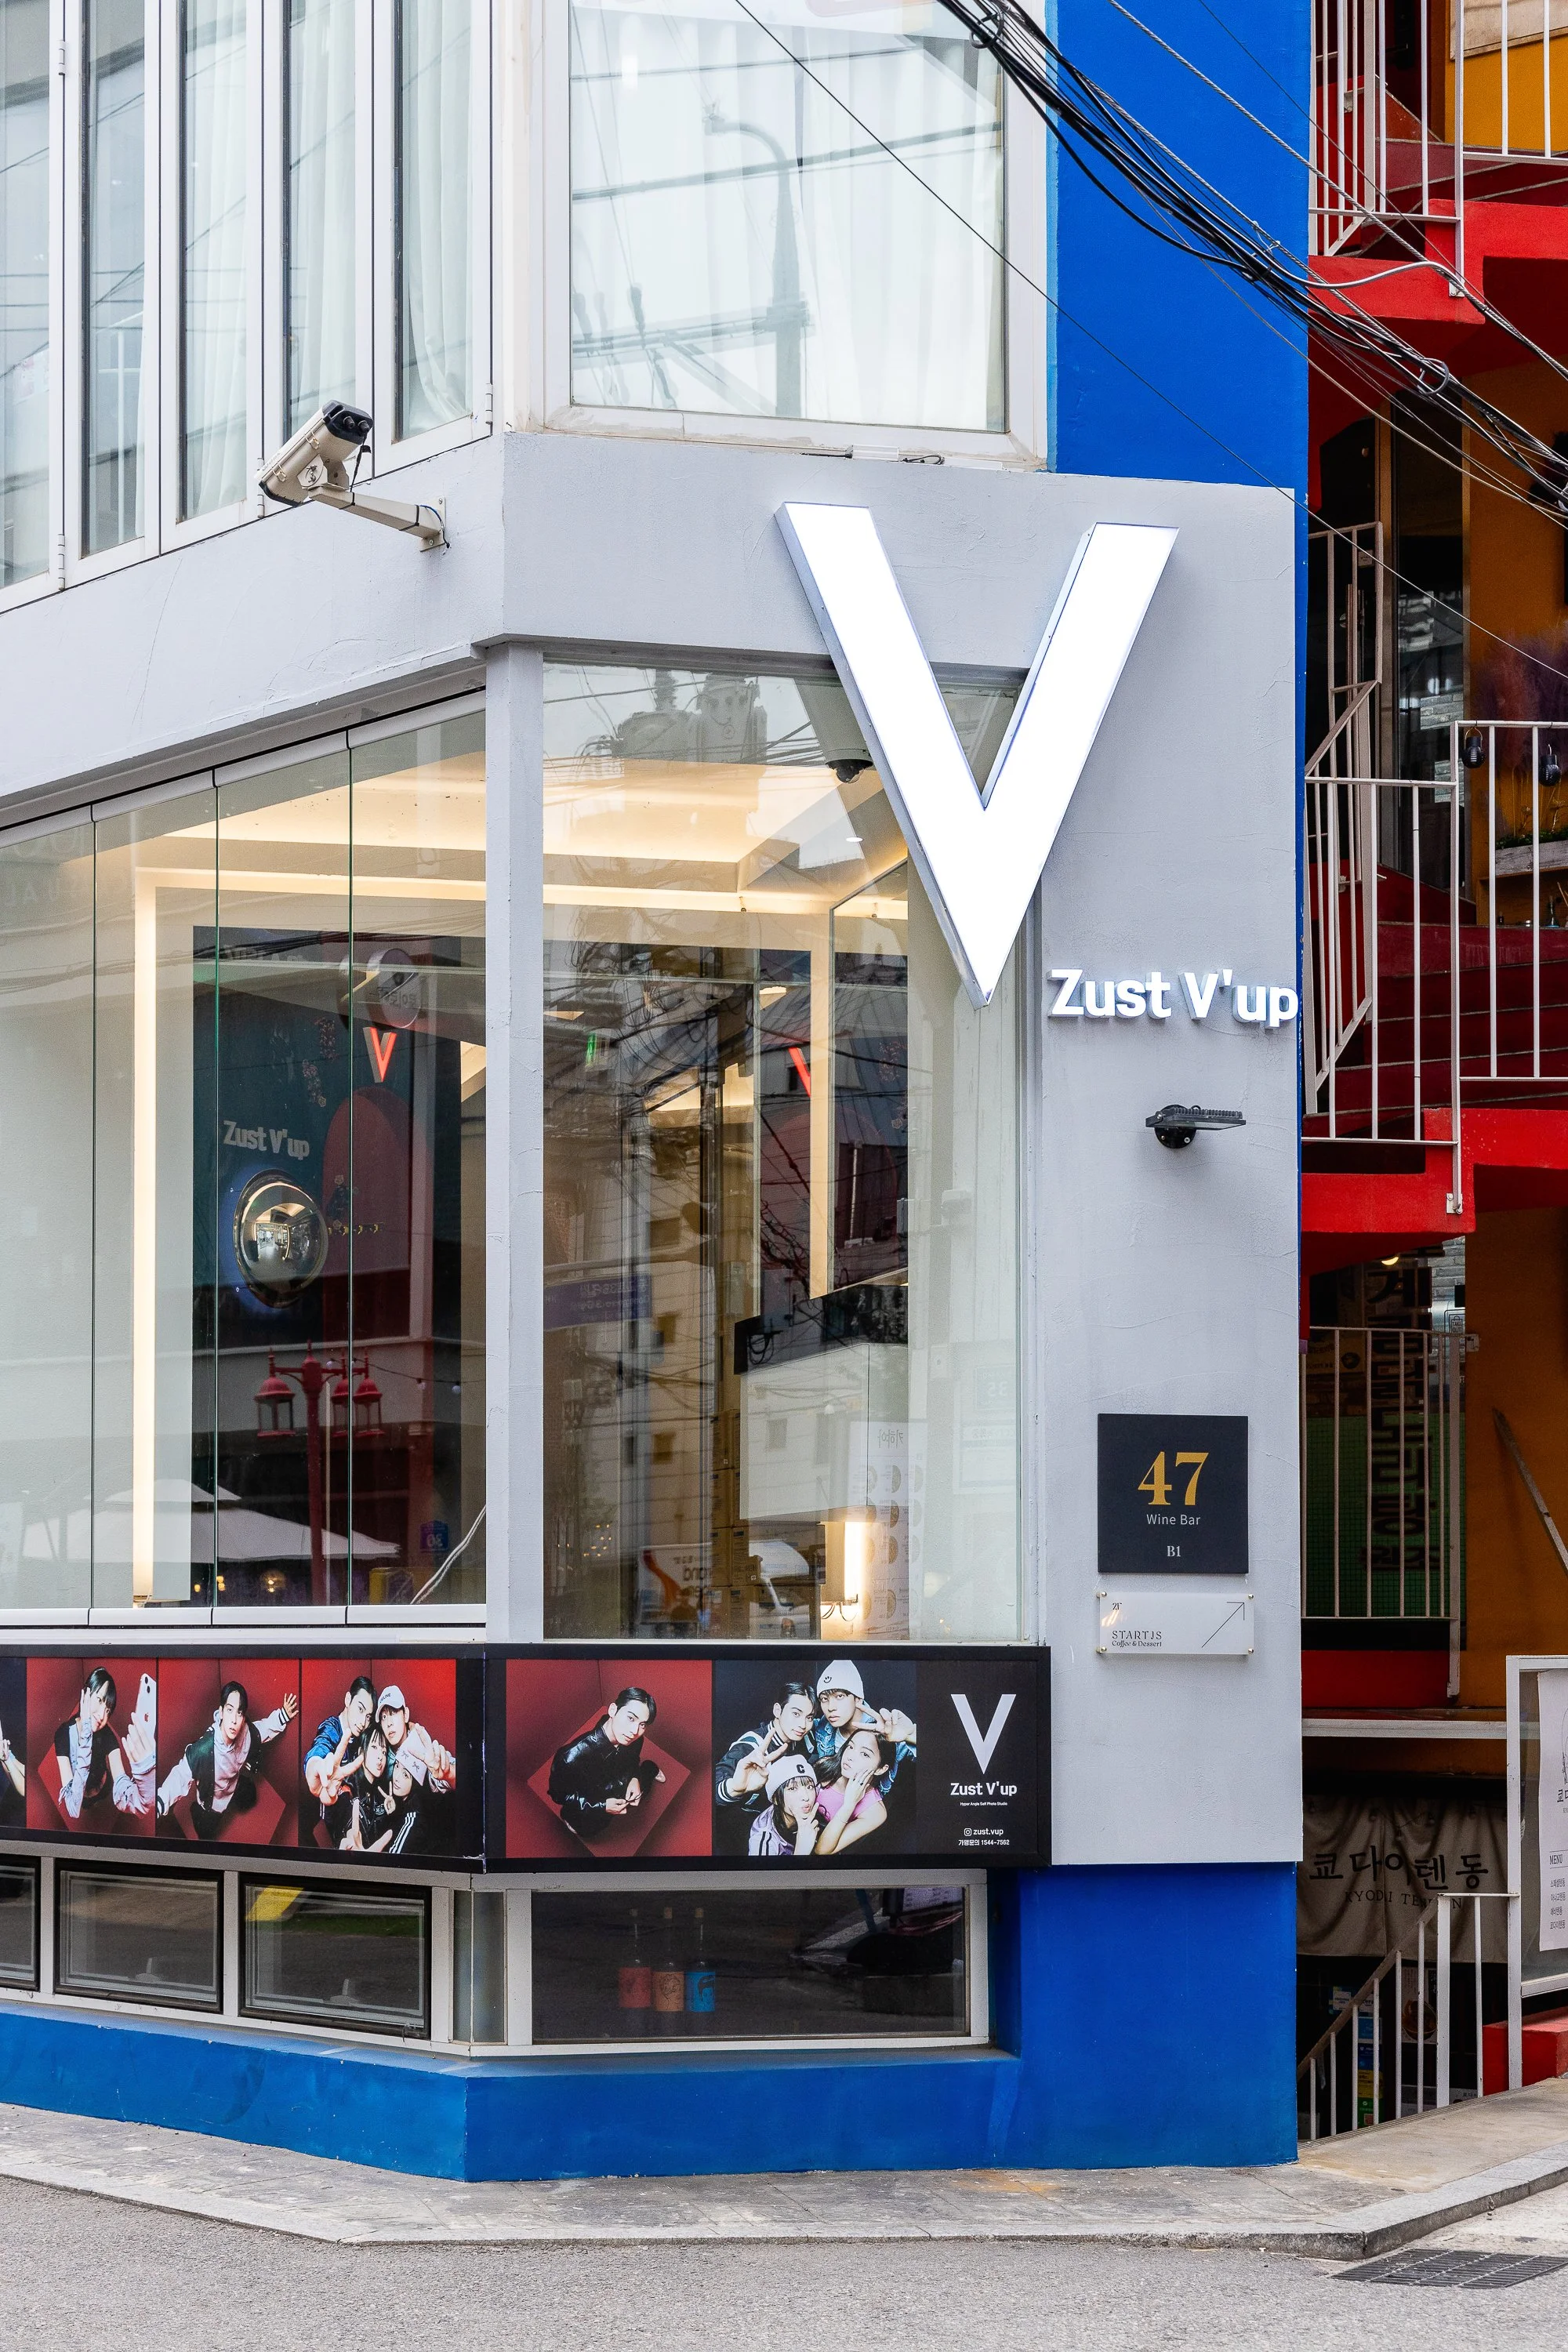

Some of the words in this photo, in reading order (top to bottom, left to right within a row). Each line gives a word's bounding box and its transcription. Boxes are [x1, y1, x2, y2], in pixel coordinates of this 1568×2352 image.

[774, 502, 1179, 1009] V
[1047, 969, 1172, 1018] Zust
[1178, 969, 1299, 1029] V'up
[363, 1026, 397, 1083] V
[223, 1120, 267, 1152] Zust
[269, 1128, 310, 1160] V'up
[1138, 1451, 1209, 1505] 47
[1146, 1514, 1176, 1525] Wine
[1180, 1514, 1200, 1525] Bar
[1167, 1545, 1181, 1557] B1
[950, 1694, 1017, 1774] V
[796, 1764, 806, 1773] C
[950, 1782, 983, 1795] Zust
[985, 1781, 1018, 1796] V'up
[973, 1828, 1004, 1837] zust.vup
[1549, 1853, 1563, 1865] MENU
[1345, 1889, 1393, 1904] KYODI
[1401, 1893, 1462, 1910] TENN
